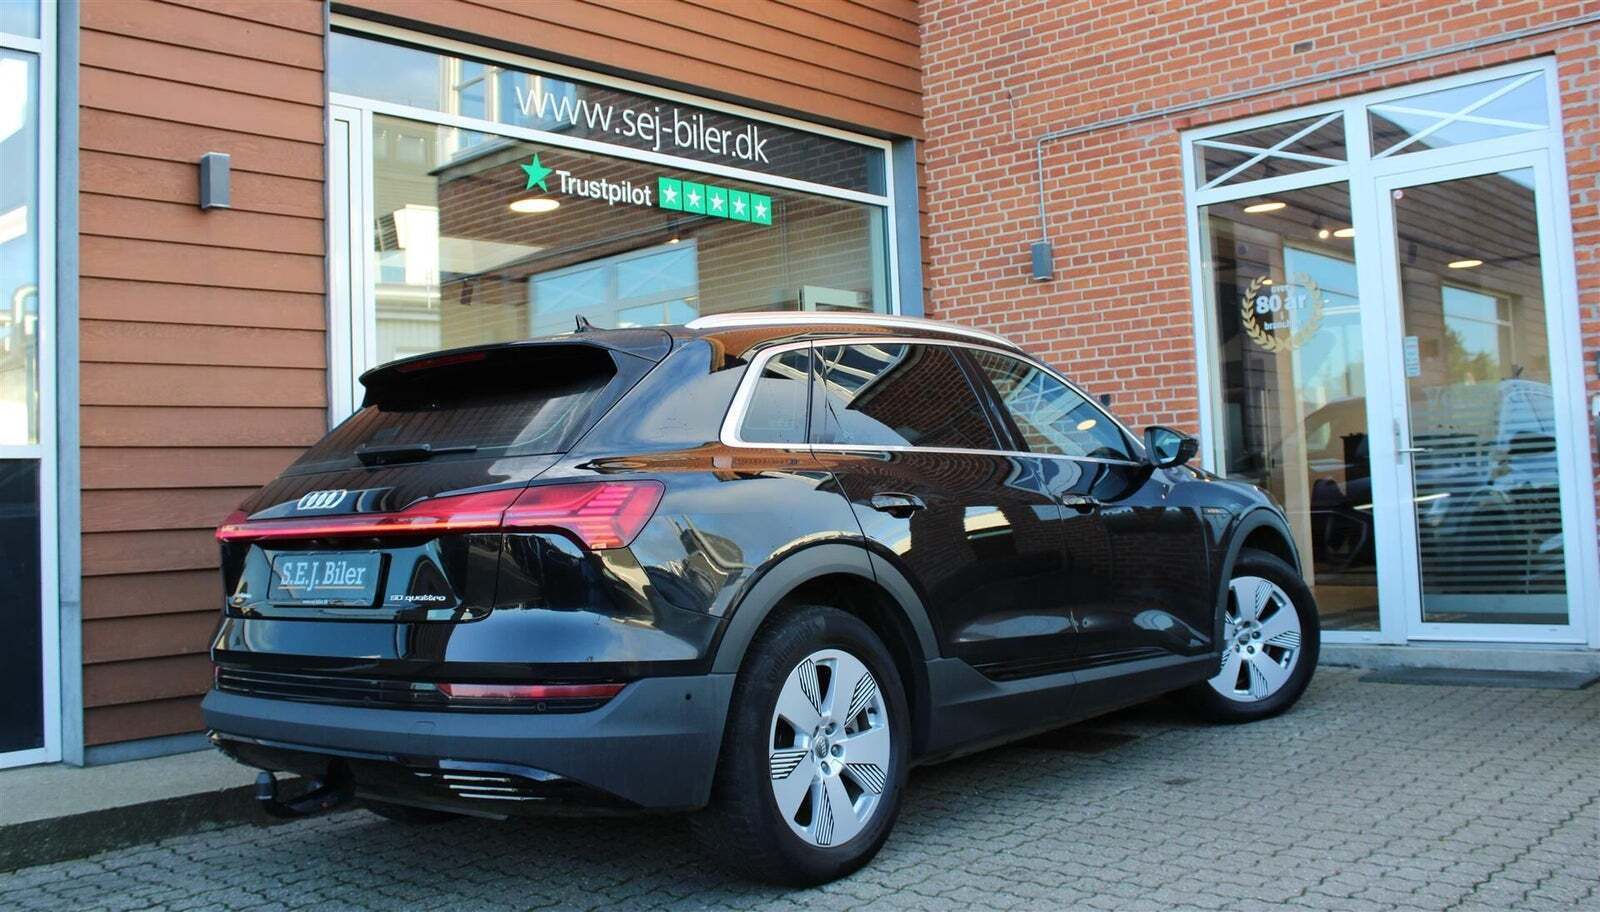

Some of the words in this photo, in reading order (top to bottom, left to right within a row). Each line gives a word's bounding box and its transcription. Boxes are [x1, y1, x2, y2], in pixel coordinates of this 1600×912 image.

[515, 86, 769, 163] www.sej-biler.dk
[555, 170, 652, 206] Trustpilot
[1256, 294, 1281, 314] 80
[280, 562, 319, 591] S.E.J.
[322, 561, 366, 585] Biler
[405, 594, 446, 602] quattro
